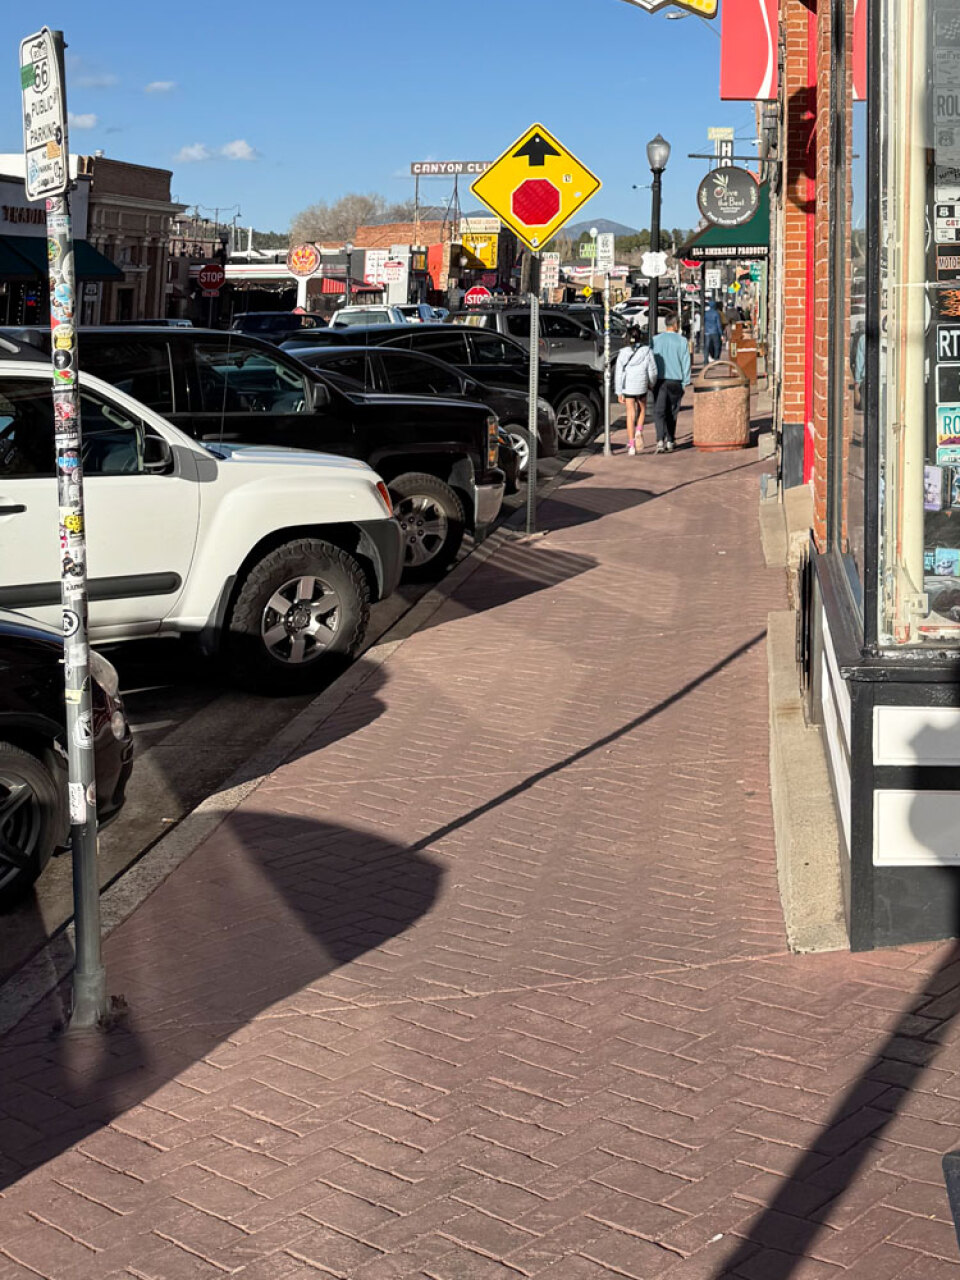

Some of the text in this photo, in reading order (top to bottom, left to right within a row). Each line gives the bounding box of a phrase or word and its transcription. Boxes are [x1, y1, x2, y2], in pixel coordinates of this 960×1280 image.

[34, 61, 49, 89] 66
[414, 163, 493, 173] CANYON CLU
[200, 272, 224, 283] STOP
[939, 329, 960, 357] RT
